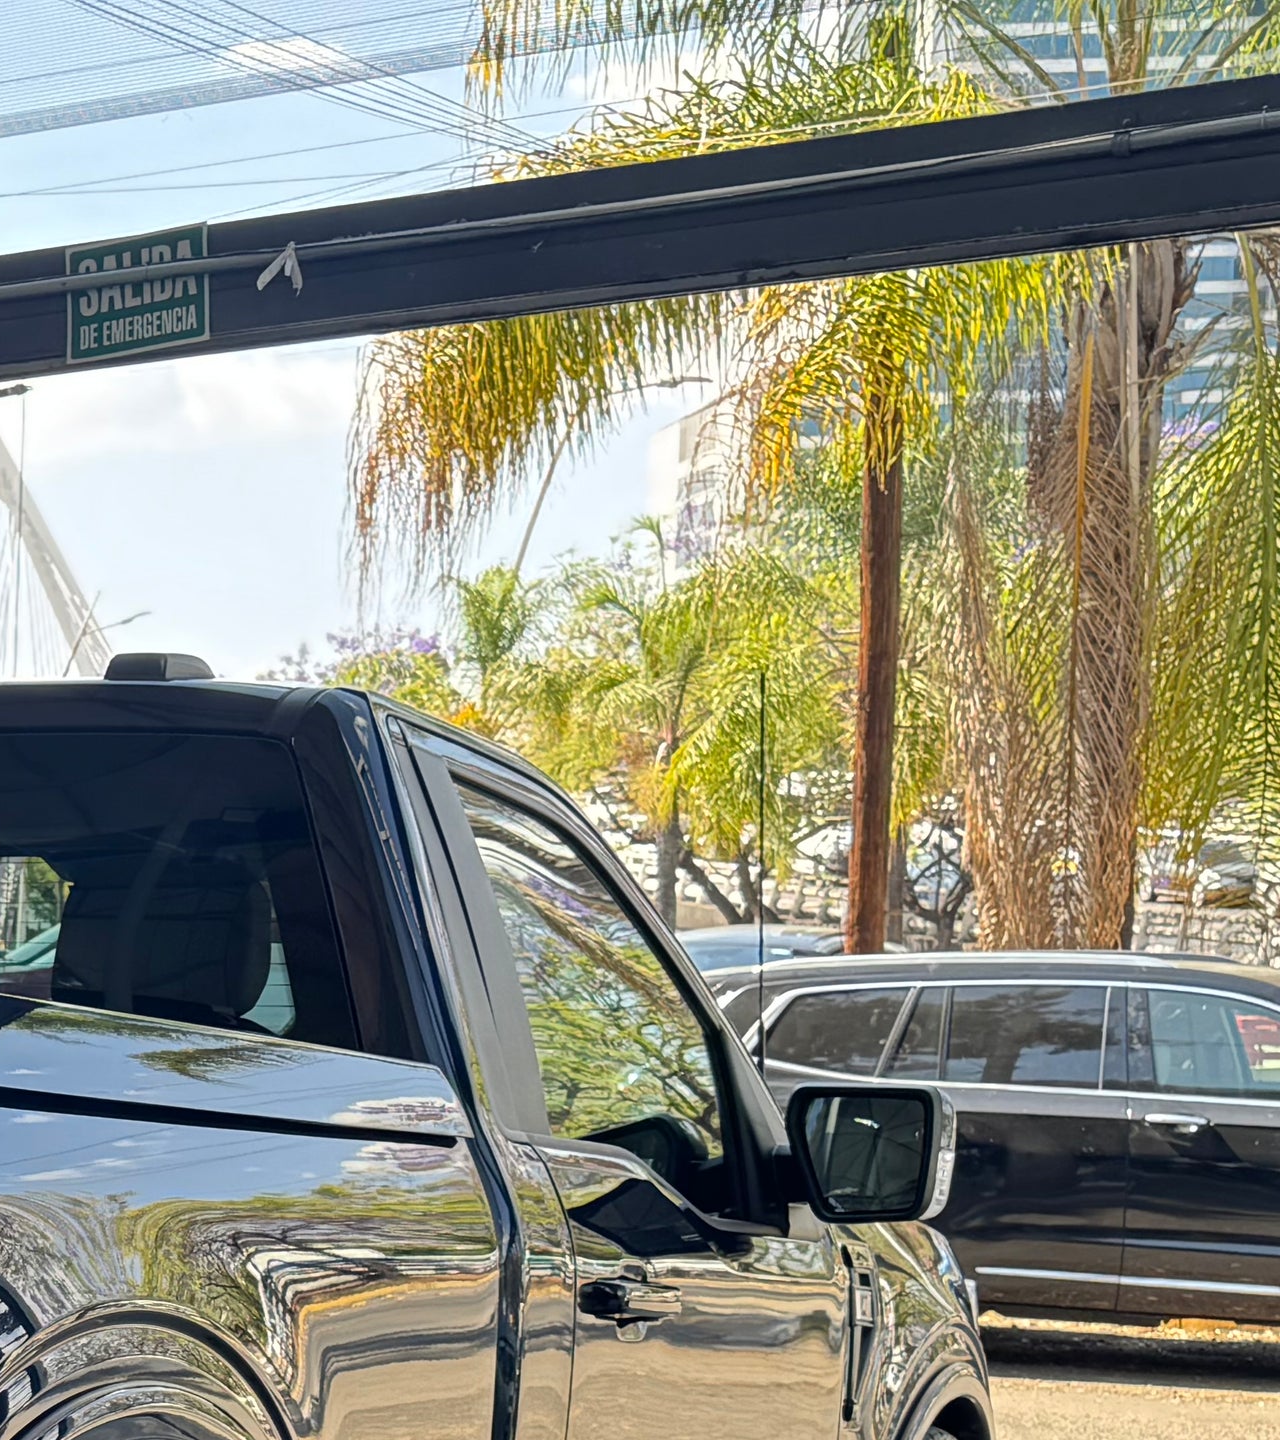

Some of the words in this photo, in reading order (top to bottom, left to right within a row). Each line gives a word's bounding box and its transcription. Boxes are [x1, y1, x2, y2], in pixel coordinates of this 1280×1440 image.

[78, 239, 198, 317] SALIDA
[79, 325, 98, 350] DE
[102, 304, 198, 346] EMERGENCIA
